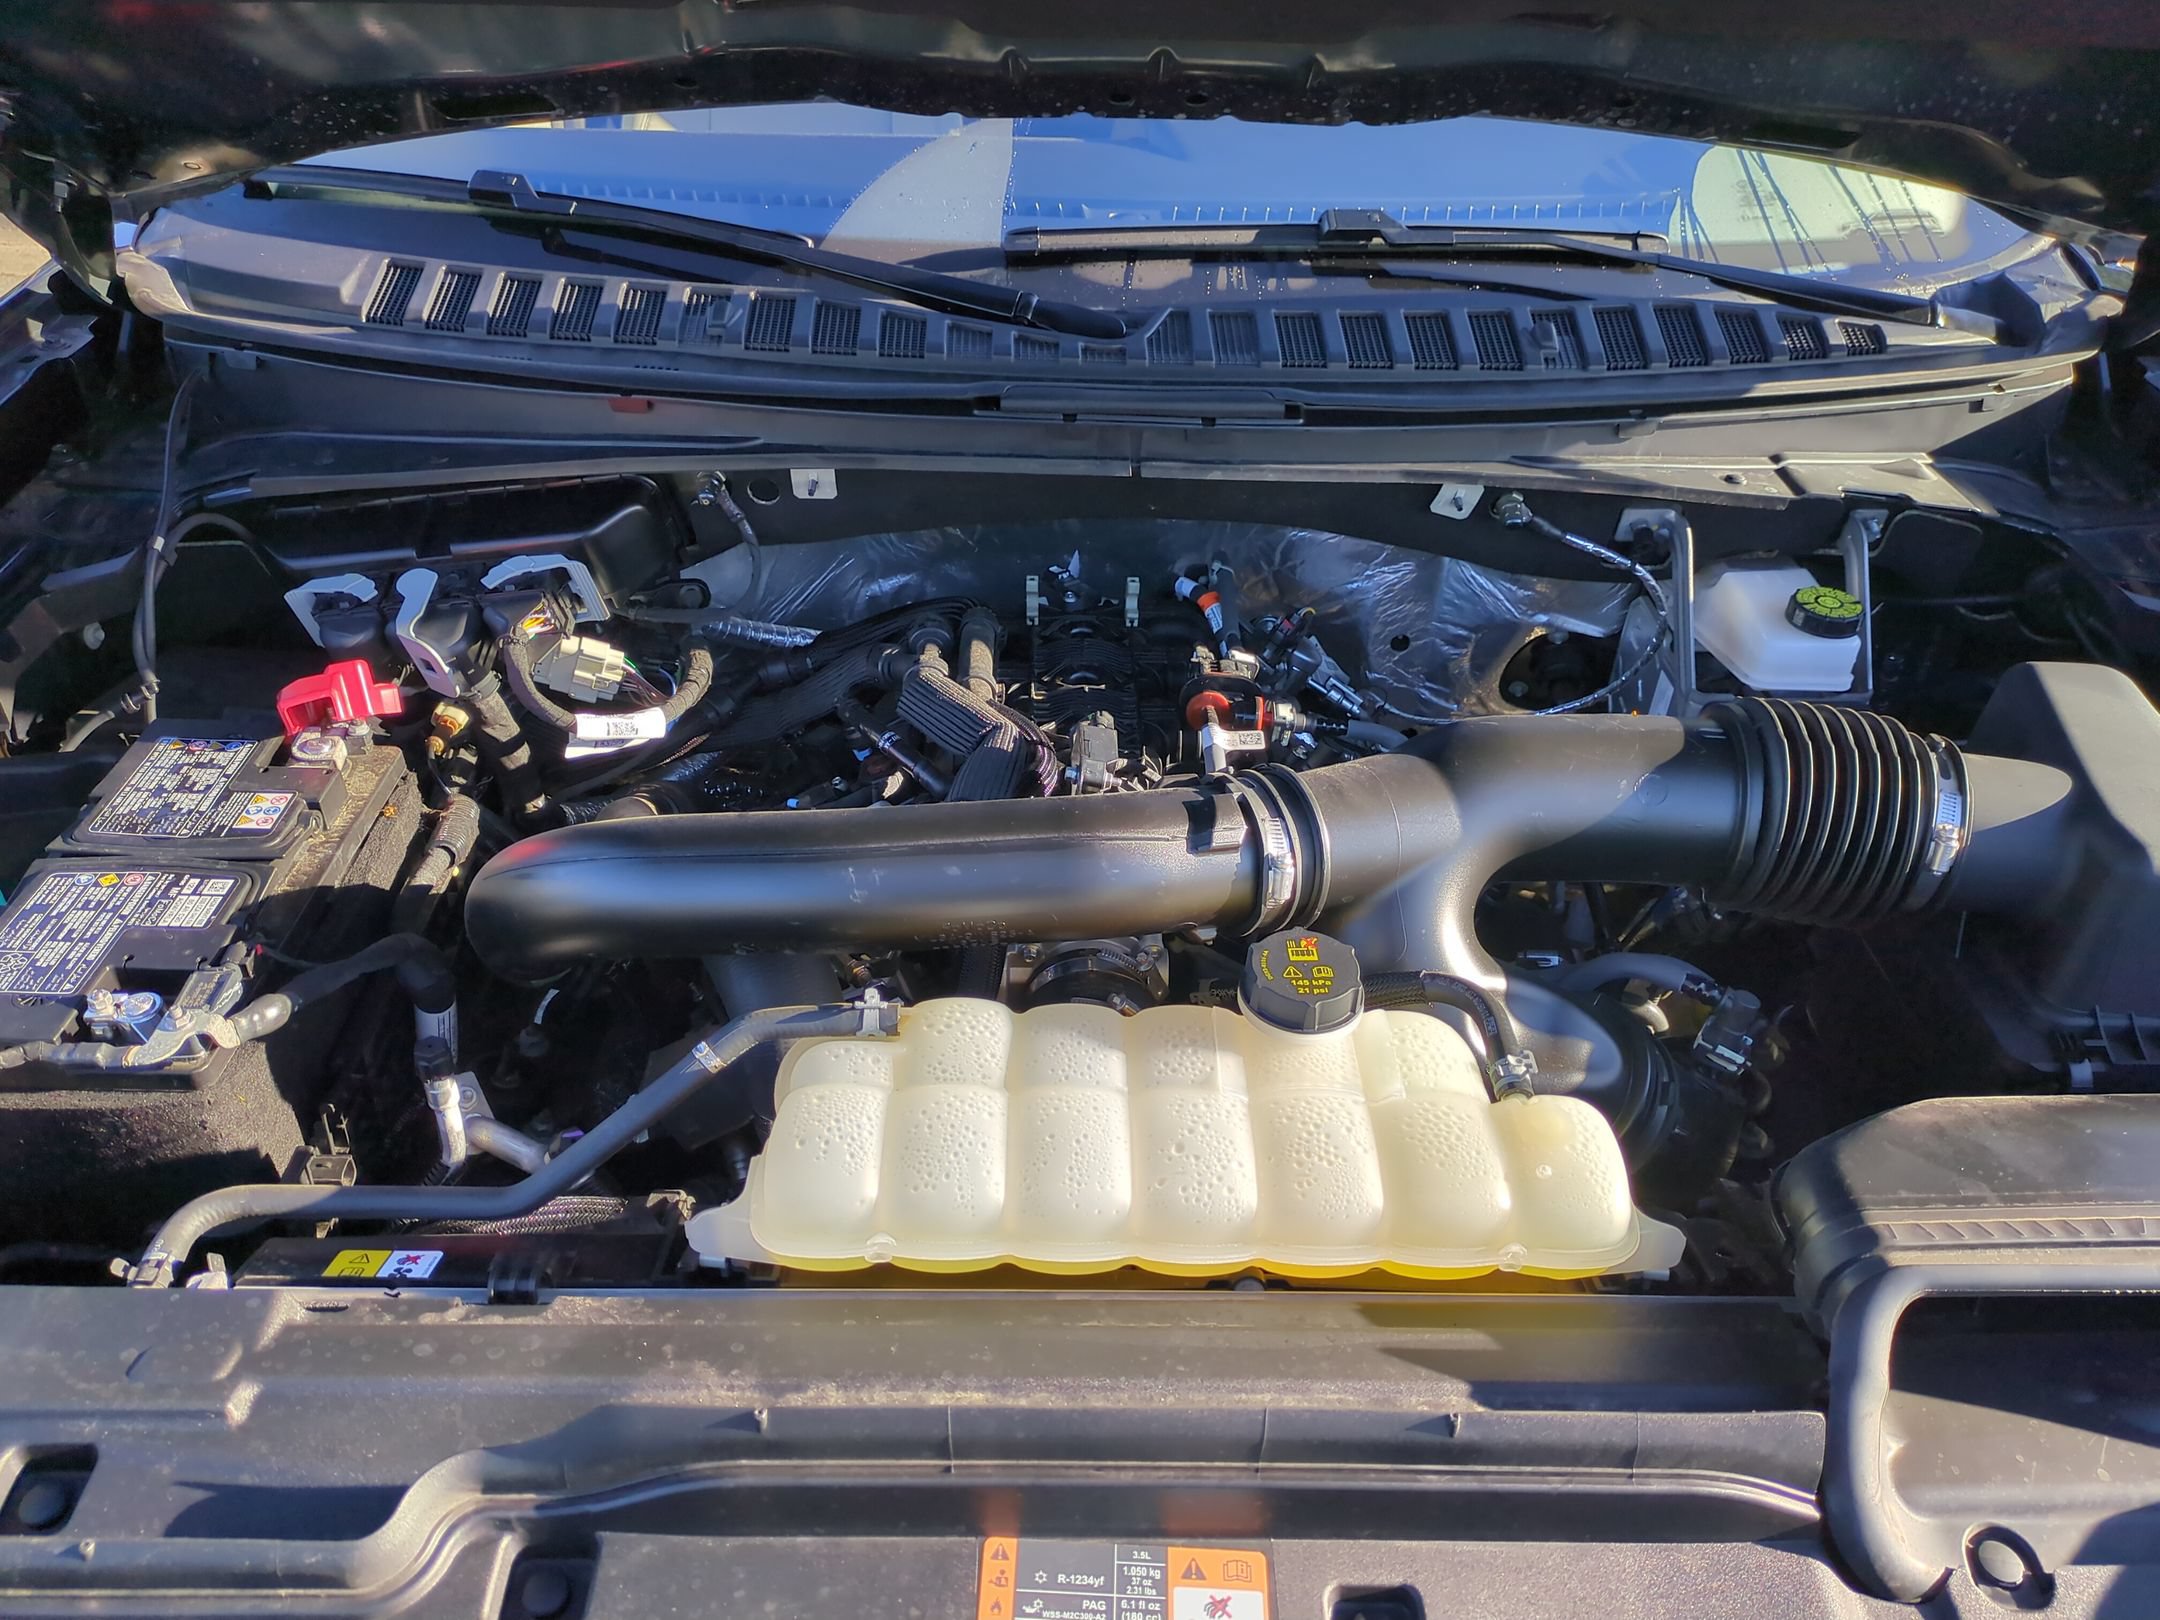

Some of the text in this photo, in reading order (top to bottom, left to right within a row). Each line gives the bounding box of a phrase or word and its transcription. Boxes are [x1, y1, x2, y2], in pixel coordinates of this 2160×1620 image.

[1313, 987, 1329, 995] psi
[1132, 1551, 1151, 1560] 3.5L
[1122, 1566, 1161, 1579] 1.050 kg
[1057, 1573, 1105, 1587] R-1234yf
[1131, 1577, 1140, 1585] 37
[1126, 1586, 1157, 1595] 2.31 lbs
[1082, 1600, 1106, 1610] PAG
[1121, 1600, 1161, 1610] 6.1 fl oz
